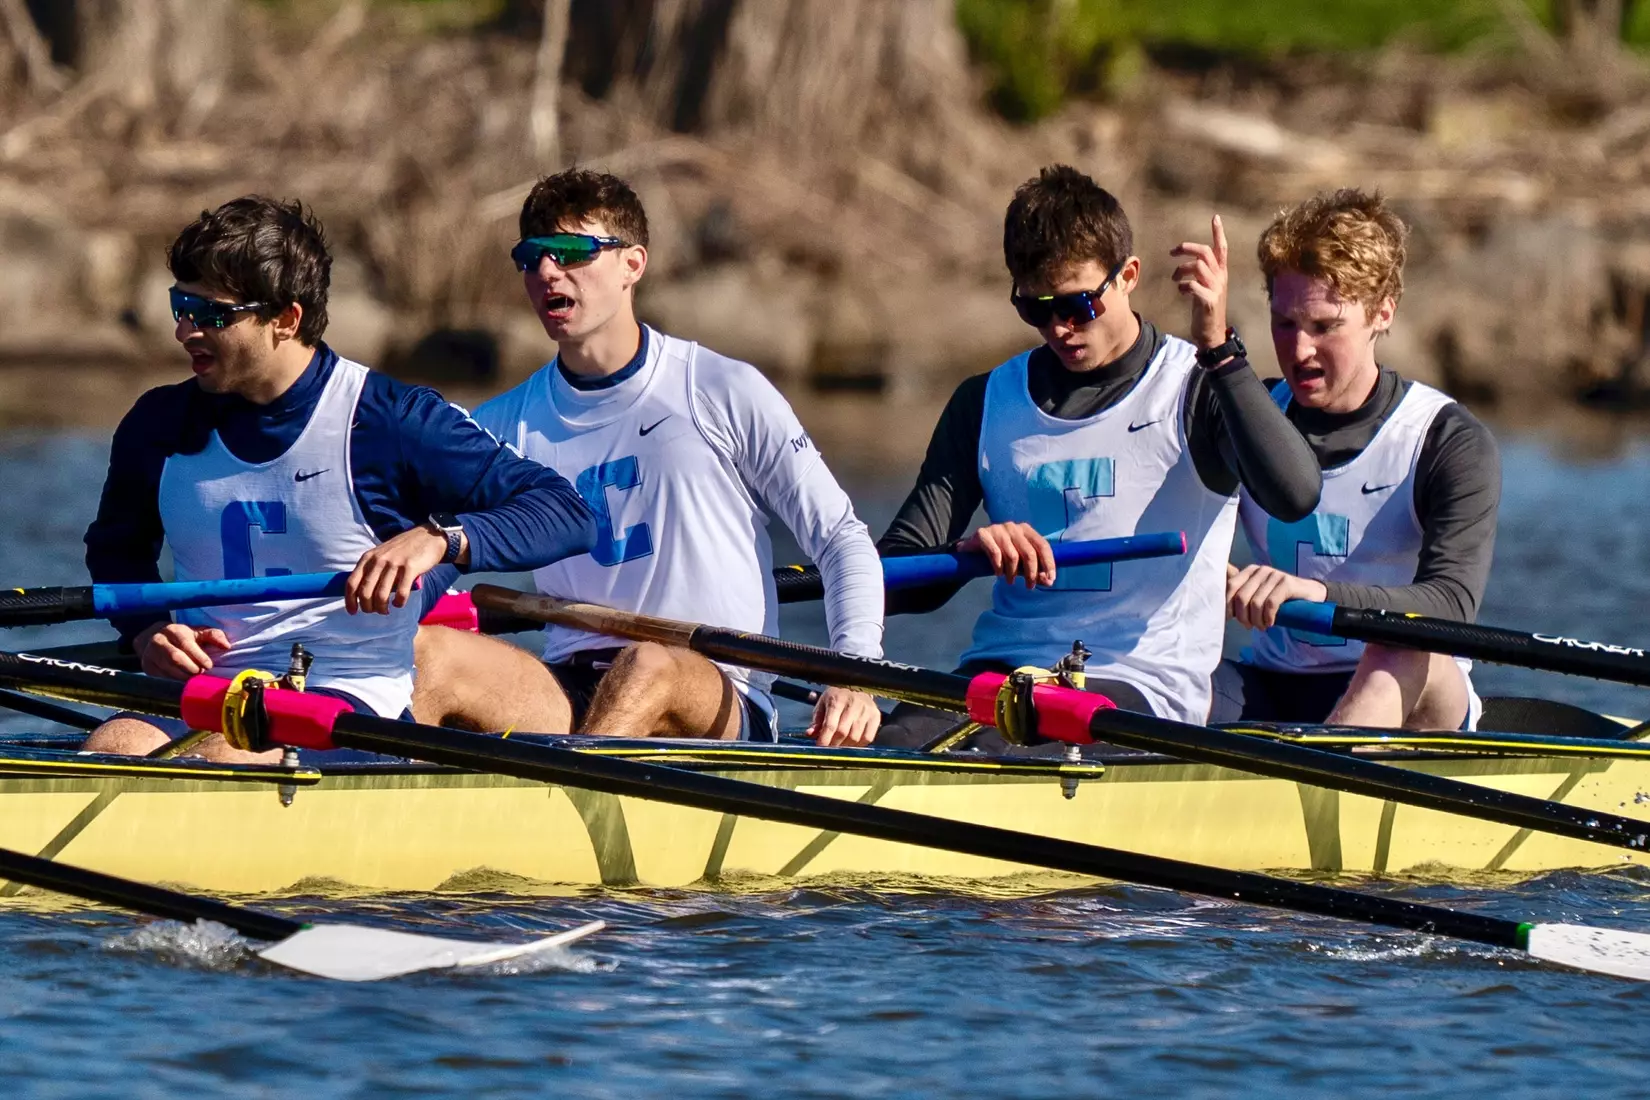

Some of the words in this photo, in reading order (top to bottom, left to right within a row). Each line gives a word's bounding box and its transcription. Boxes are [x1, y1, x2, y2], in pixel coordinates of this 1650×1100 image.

[221, 501, 292, 580] C
[575, 455, 654, 567] C
[1027, 457, 1116, 592] C
